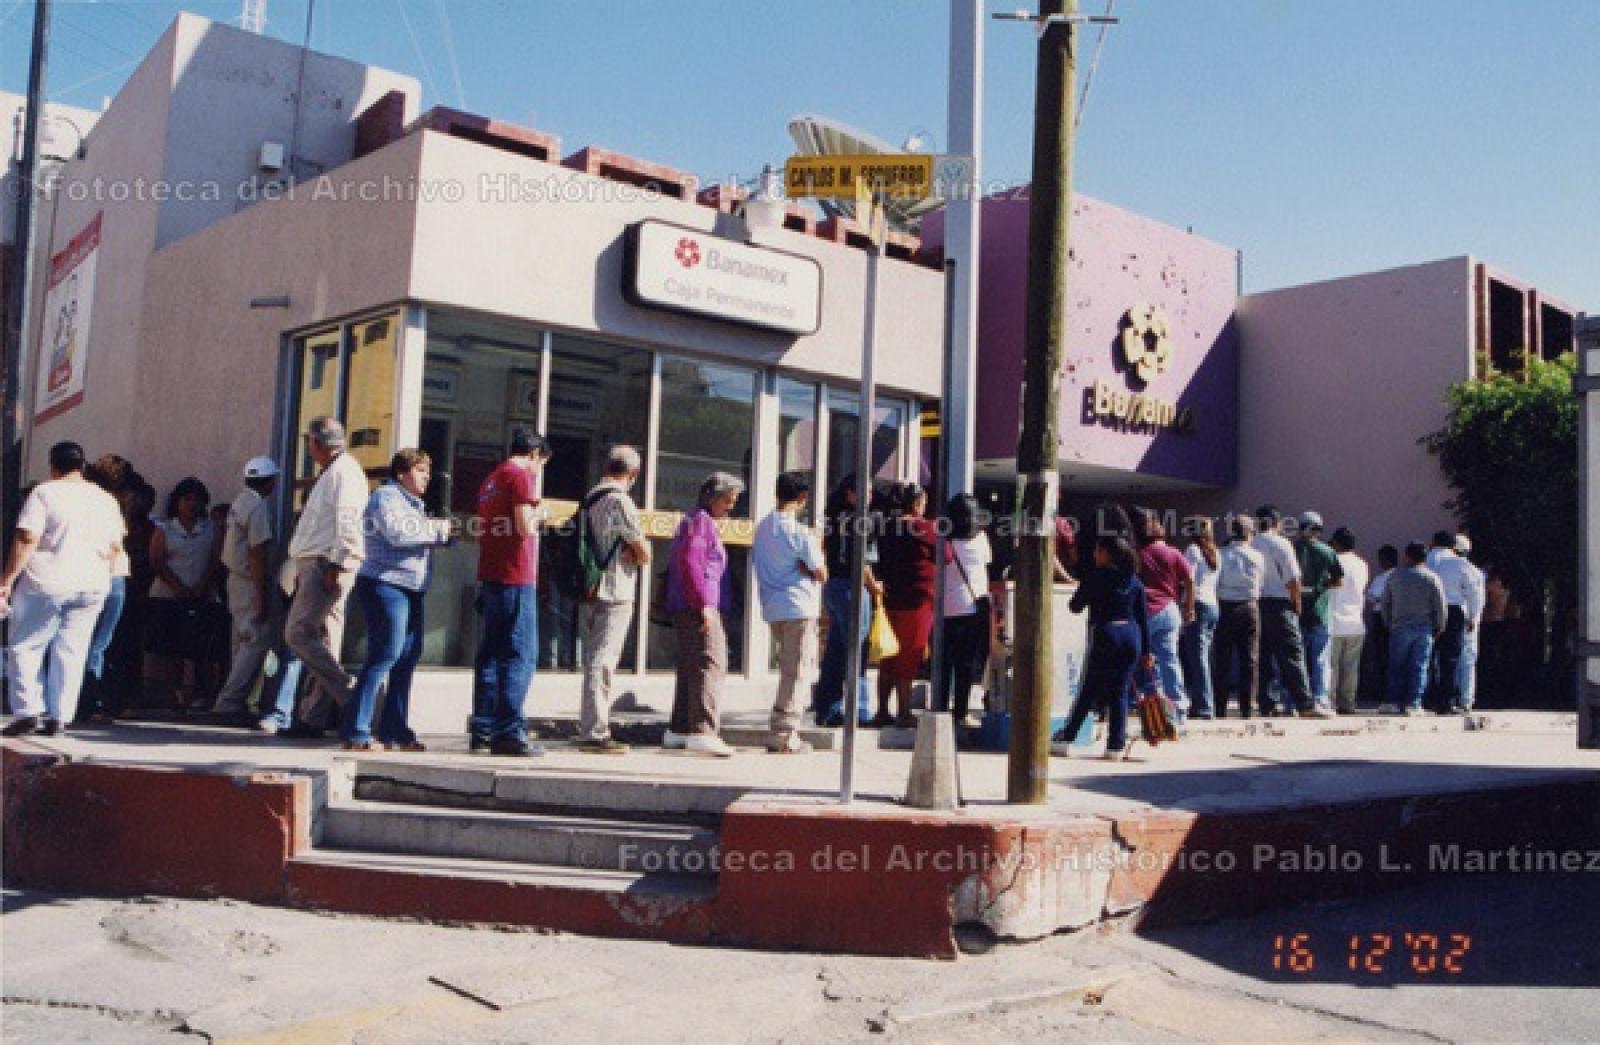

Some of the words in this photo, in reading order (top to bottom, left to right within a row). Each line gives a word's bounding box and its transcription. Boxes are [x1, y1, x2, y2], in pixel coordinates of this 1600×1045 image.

[791, 166, 835, 188] CARLOS
[705, 247, 789, 288] Banamex
[663, 276, 701, 302] Caja
